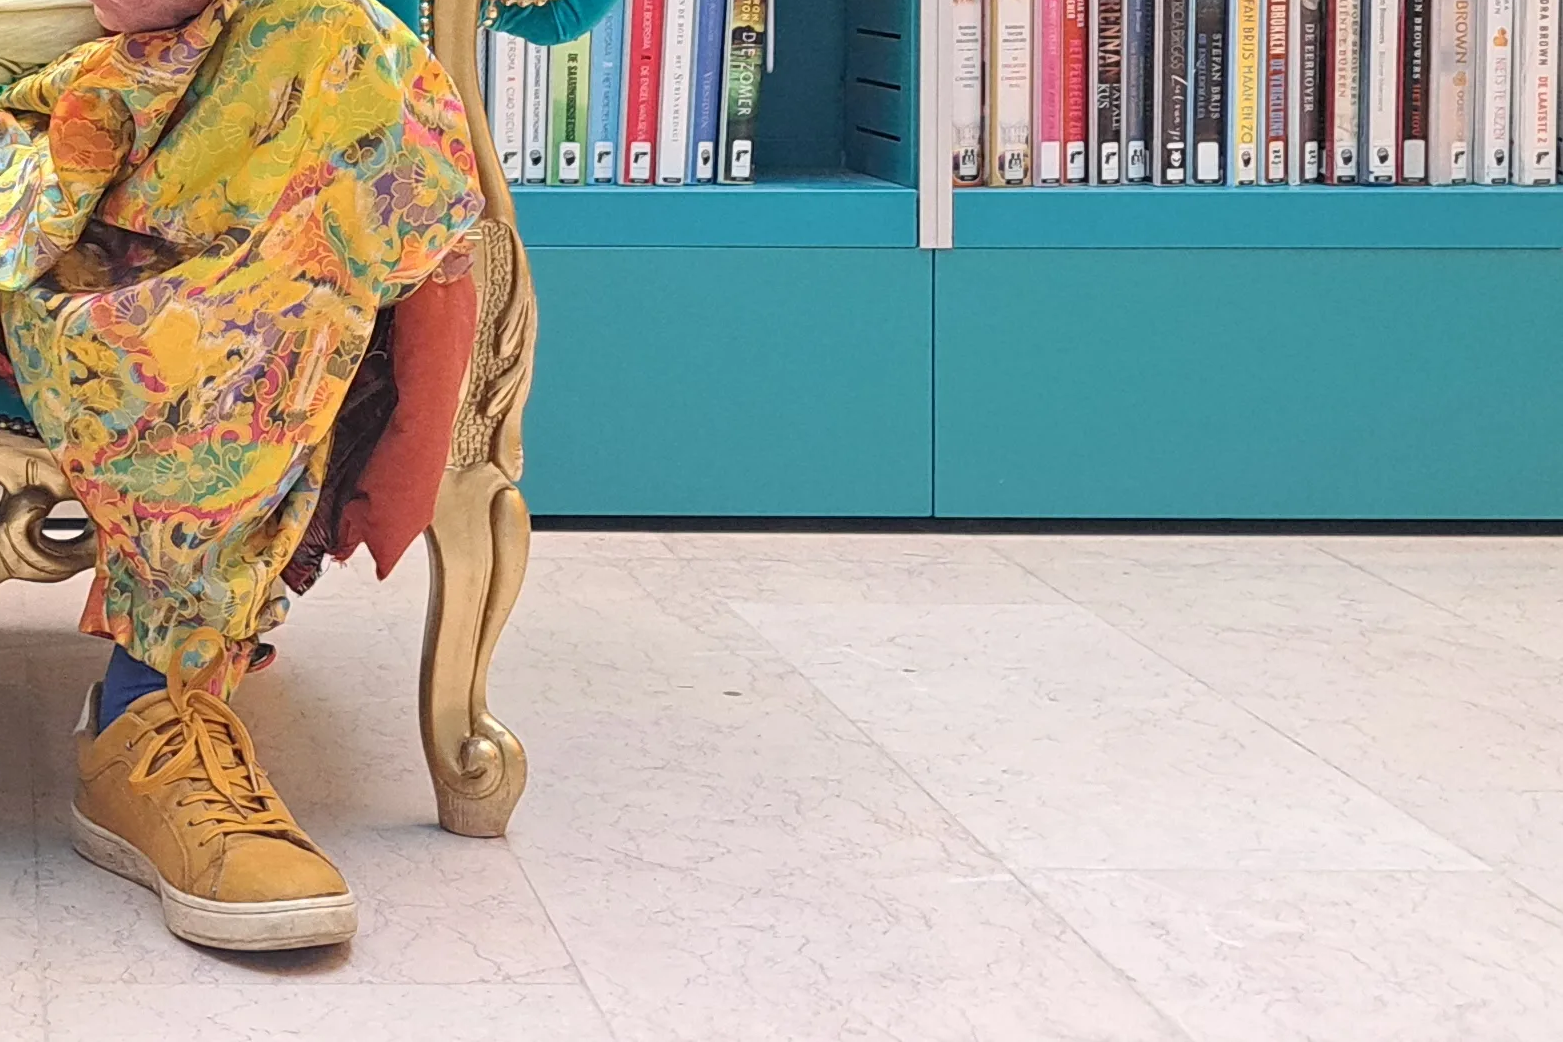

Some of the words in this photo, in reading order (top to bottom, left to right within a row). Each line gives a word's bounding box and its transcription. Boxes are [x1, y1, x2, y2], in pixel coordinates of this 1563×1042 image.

[1242, 27, 1253, 61] BRIJS
[1270, 5, 1286, 54] BROKKEN
[1305, 23, 1315, 43] DE
[1411, 18, 1422, 79] BROUWERS
[1455, 0, 1468, 64] BROWN
[1538, 25, 1549, 66] BROWN
[1210, 33, 1222, 82] STEFAN
[738, 62, 755, 116] ZOMER
[1097, 83, 1110, 110] KUS
[1242, 65, 1253, 103] MAAN
[1303, 45, 1315, 112] EERROVER
[1538, 76, 1548, 89] DE
[1209, 87, 1221, 119] BRIJS
[1242, 106, 1253, 120] EN
